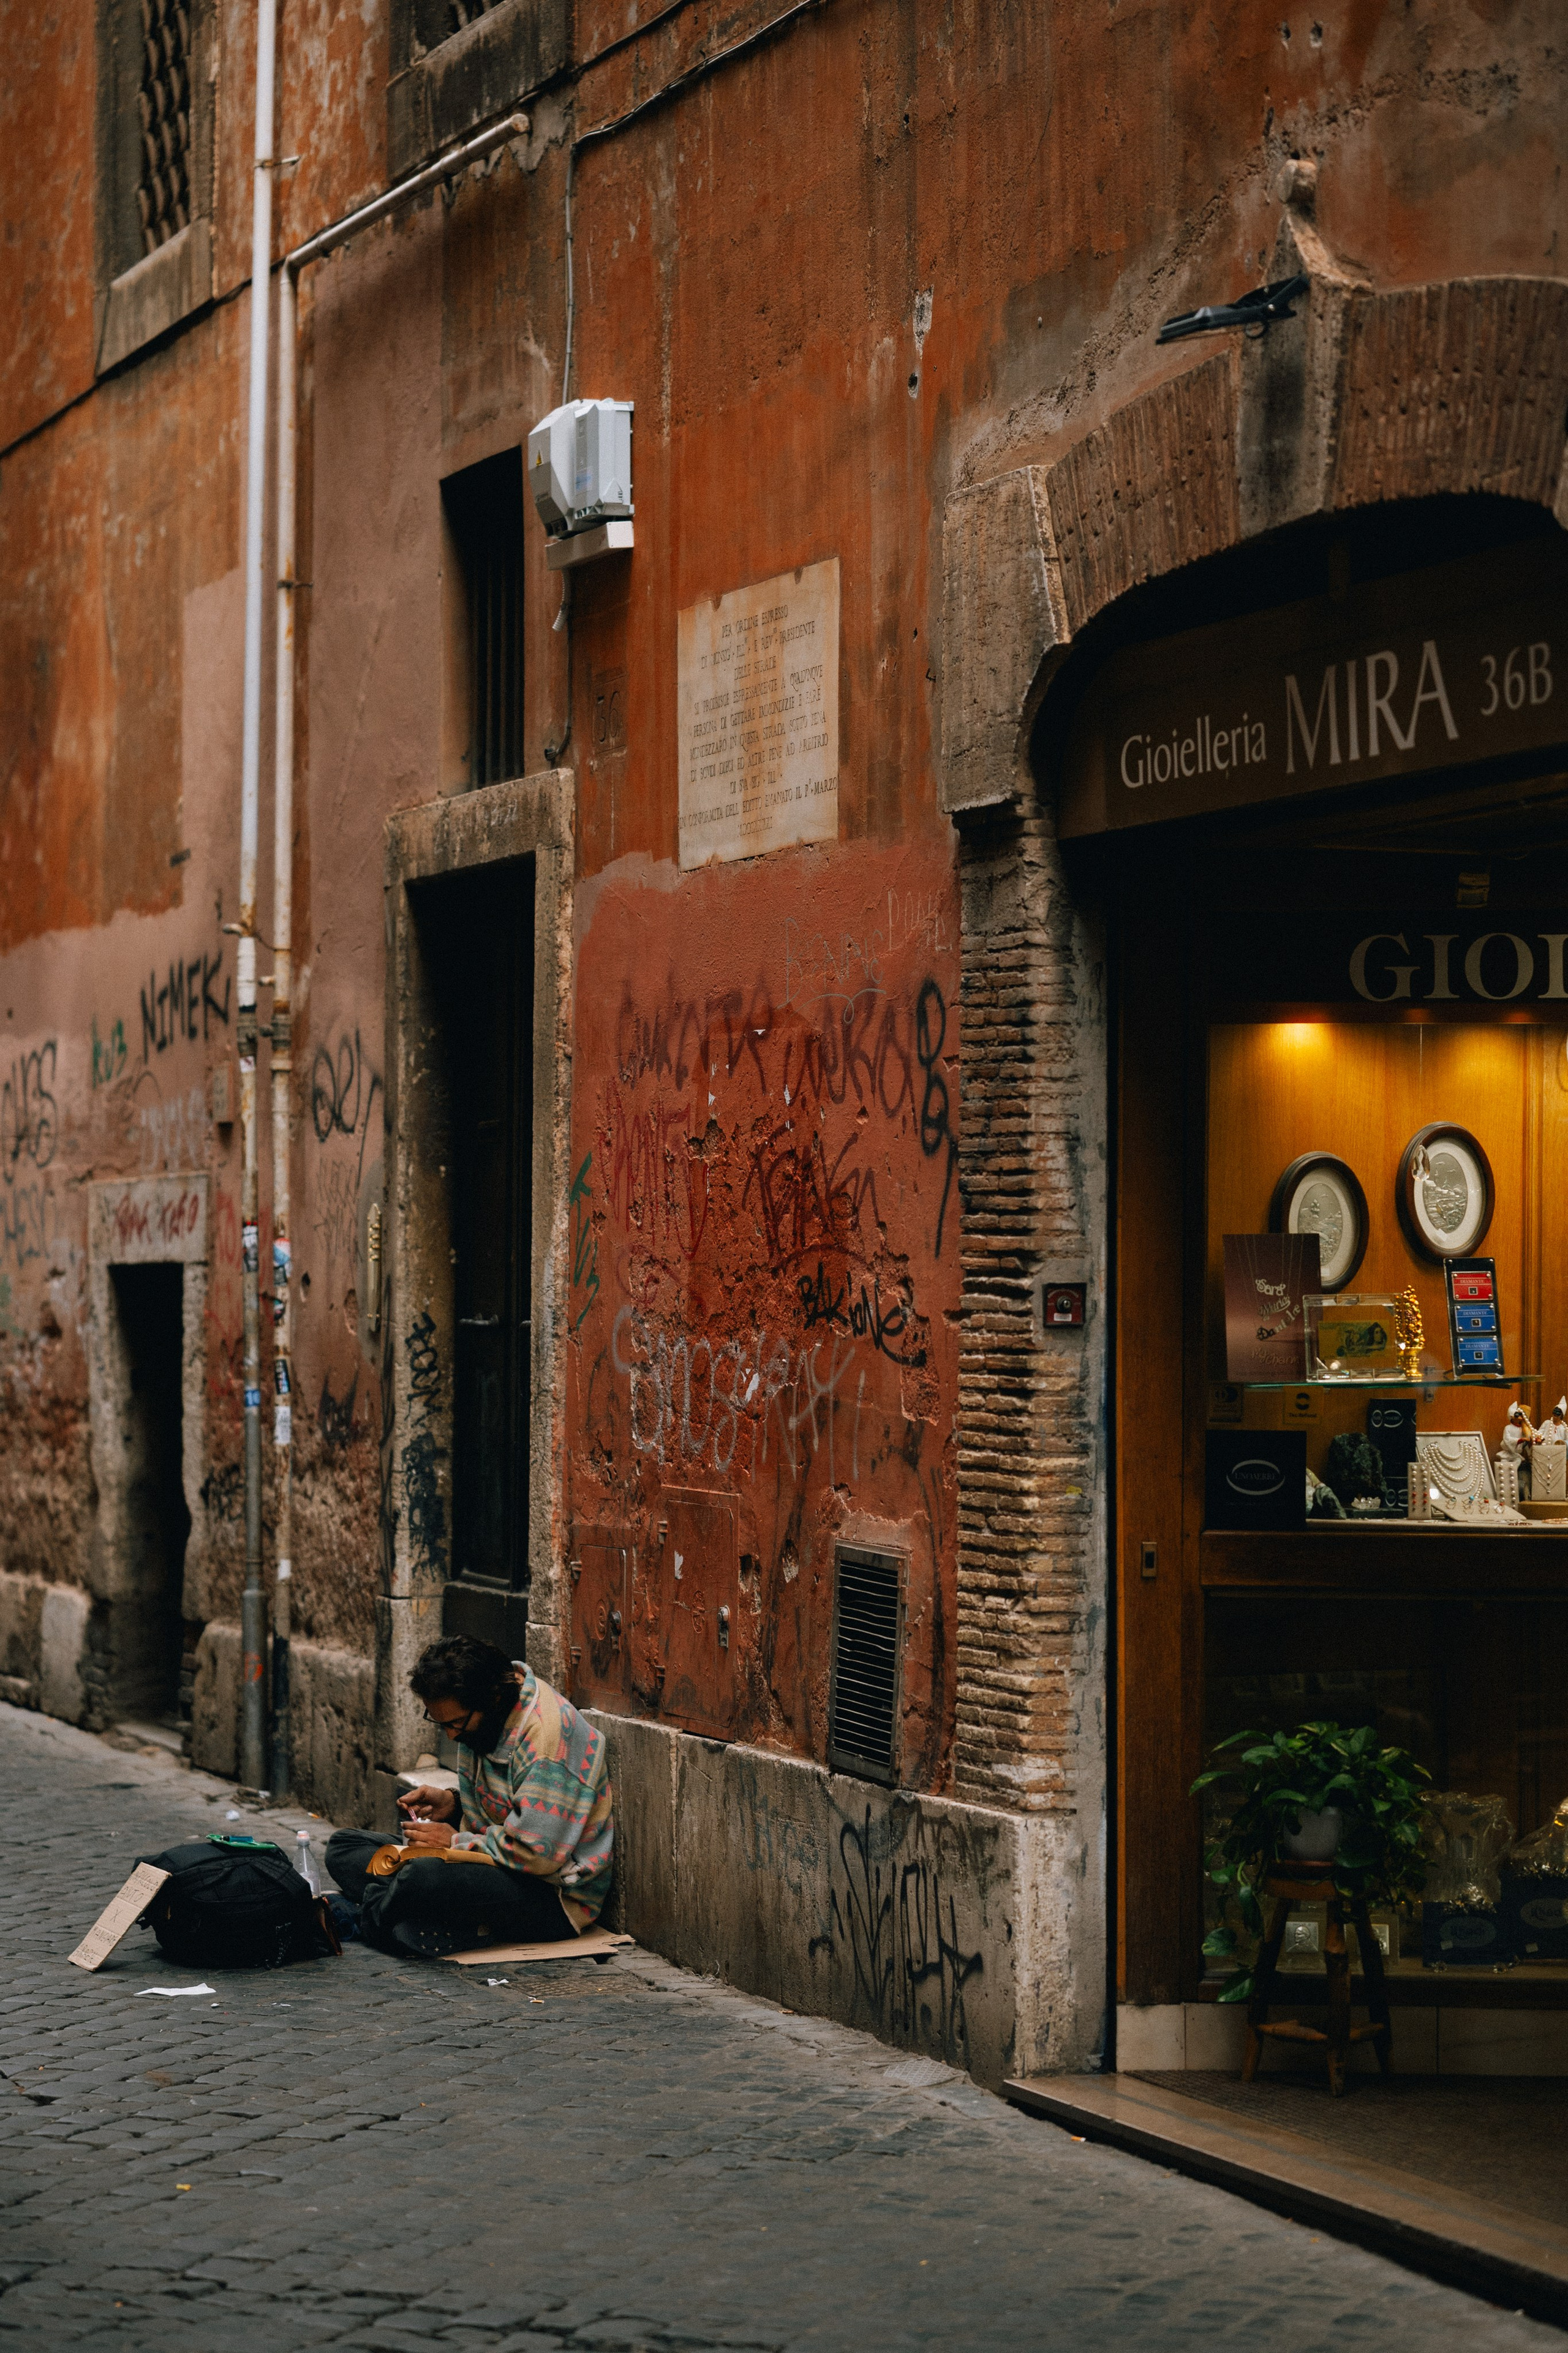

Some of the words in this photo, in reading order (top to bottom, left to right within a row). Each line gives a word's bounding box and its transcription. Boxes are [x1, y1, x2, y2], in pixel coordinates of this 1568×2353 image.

[722, 622, 732, 638] PER
[735, 614, 758, 633] ORDINE
[761, 603, 788, 625] ESPRESSO
[778, 619, 815, 644] PRESIDENTE
[734, 663, 751, 681] DELLE
[753, 655, 776, 674] STRADE
[703, 693, 729, 712] PROIBISCE
[733, 678, 777, 703] ESPRESSAMENTE
[1120, 712, 1267, 788] Gioielleria
[1285, 640, 1460, 774] MIRA
[1479, 641, 1554, 716] 36B
[693, 719, 717, 738] PERSONA
[720, 715, 727, 730] DI
[730, 707, 755, 727] GETTARE
[758, 695, 794, 719] IMMONDIZIE
[690, 738, 726, 761] MONDEZZARO
[729, 735, 737, 749] IN
[763, 722, 786, 740] STRADA
[789, 714, 808, 732] SOTTO
[690, 769, 696, 782] DI
[718, 758, 733, 774] DIECI
[737, 756, 744, 770] ED
[768, 745, 782, 761] PENE
[785, 741, 795, 757] AD
[798, 731, 828, 753] ARBITRIO
[729, 780, 736, 794] DI
[742, 796, 762, 814] EDITTO
[764, 787, 793, 807] EMANATO
[795, 785, 802, 799] IL
[813, 776, 837, 795] MARZO
[1349, 932, 1568, 1002] GIOI
